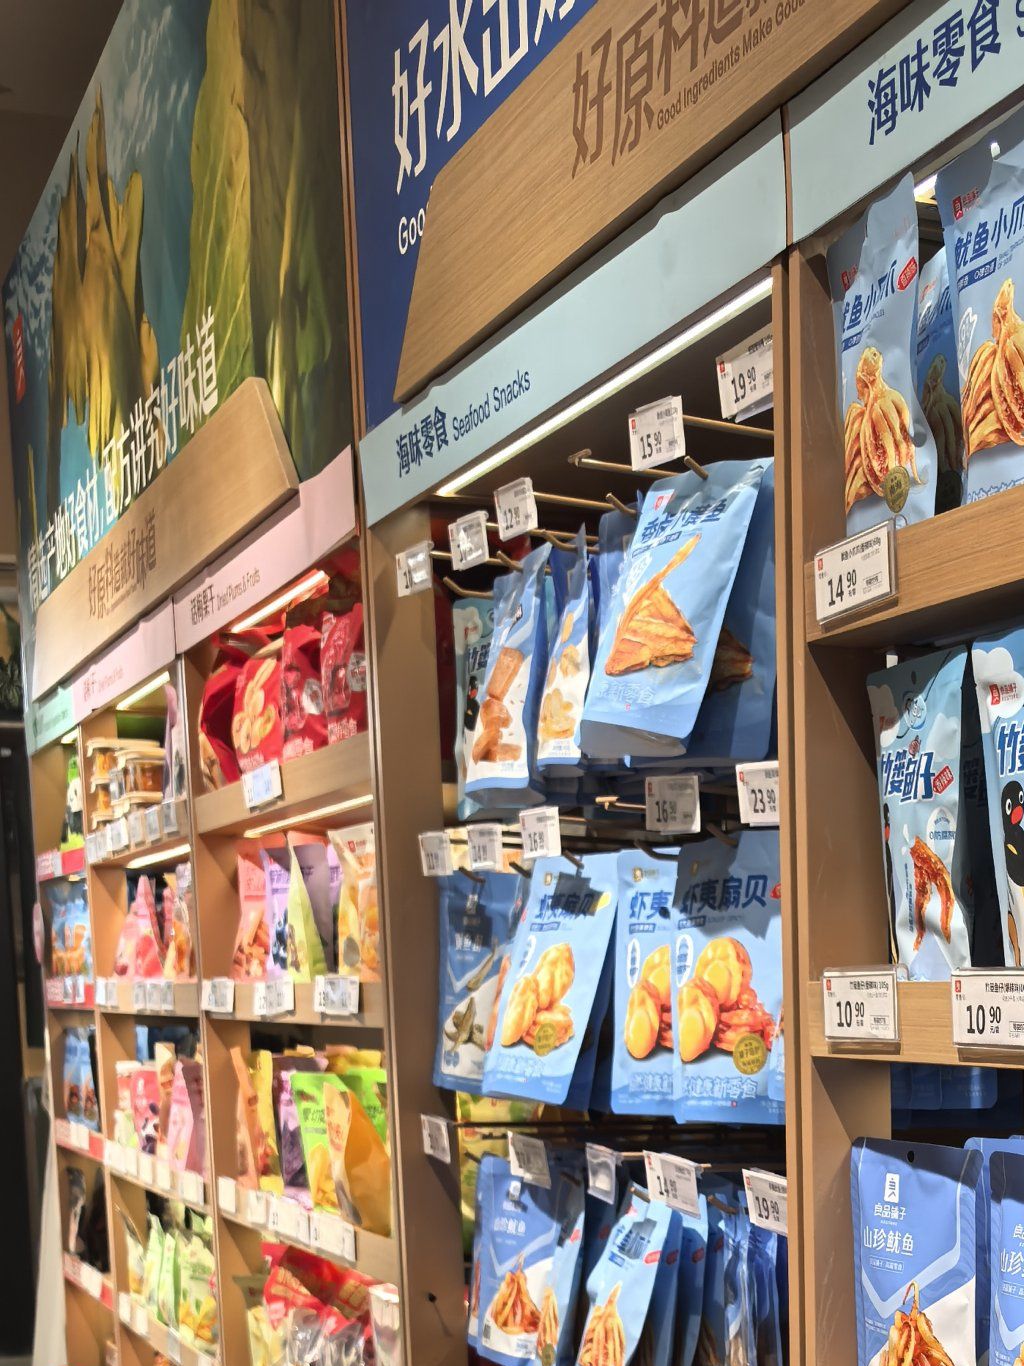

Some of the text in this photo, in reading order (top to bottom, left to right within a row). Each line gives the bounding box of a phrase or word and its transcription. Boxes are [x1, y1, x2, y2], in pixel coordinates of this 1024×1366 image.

[656, 99, 682, 130] Good
[681, 49, 740, 112] Ingredients
[742, 20, 772, 61] Make
[867, 0, 1001, 145] 海味零食
[392, 0, 580, 195] 好水出
[399, 205, 425, 254] Goo
[731, 366, 757, 405] 19 90
[396, 369, 532, 479] 海味零食 Seafood Snacks
[639, 432, 662, 460] 15 90
[503, 508, 514, 531] 12
[828, 569, 857, 607] 14 90
[655, 800, 669, 823] 16
[751, 787, 776, 814] 23 90
[836, 1000, 865, 1028] 10 90
[966, 1004, 1001, 1034] 10 90
[755, 1196, 771, 1220] 19
[874, 1202, 907, 1221] 良品铺子
[863, 1225, 914, 1257] 山珍鱿鱼
